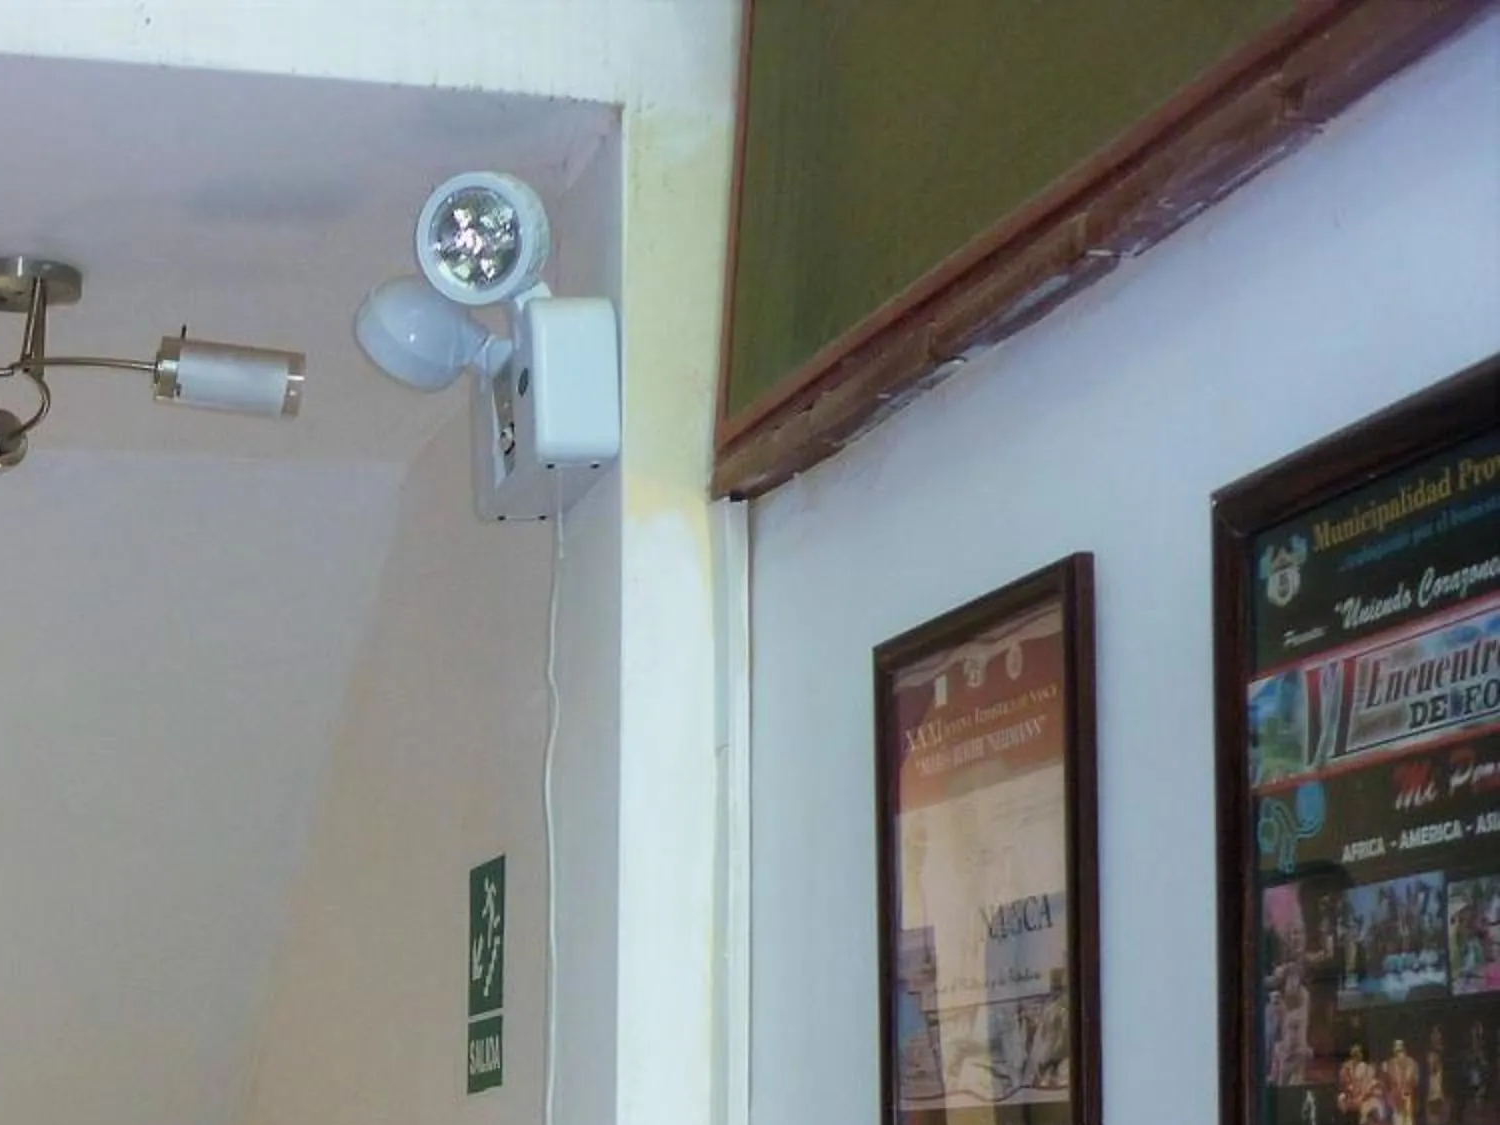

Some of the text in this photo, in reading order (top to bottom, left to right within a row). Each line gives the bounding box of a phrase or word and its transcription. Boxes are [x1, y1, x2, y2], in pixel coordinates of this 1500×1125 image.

[1311, 466, 1452, 553] Municipalidad
[1366, 637, 1500, 709] Encuentr
[1342, 836, 1387, 864] AFRICA
[1399, 819, 1464, 850] AMERICA
[469, 1034, 501, 1076] SALIDA
